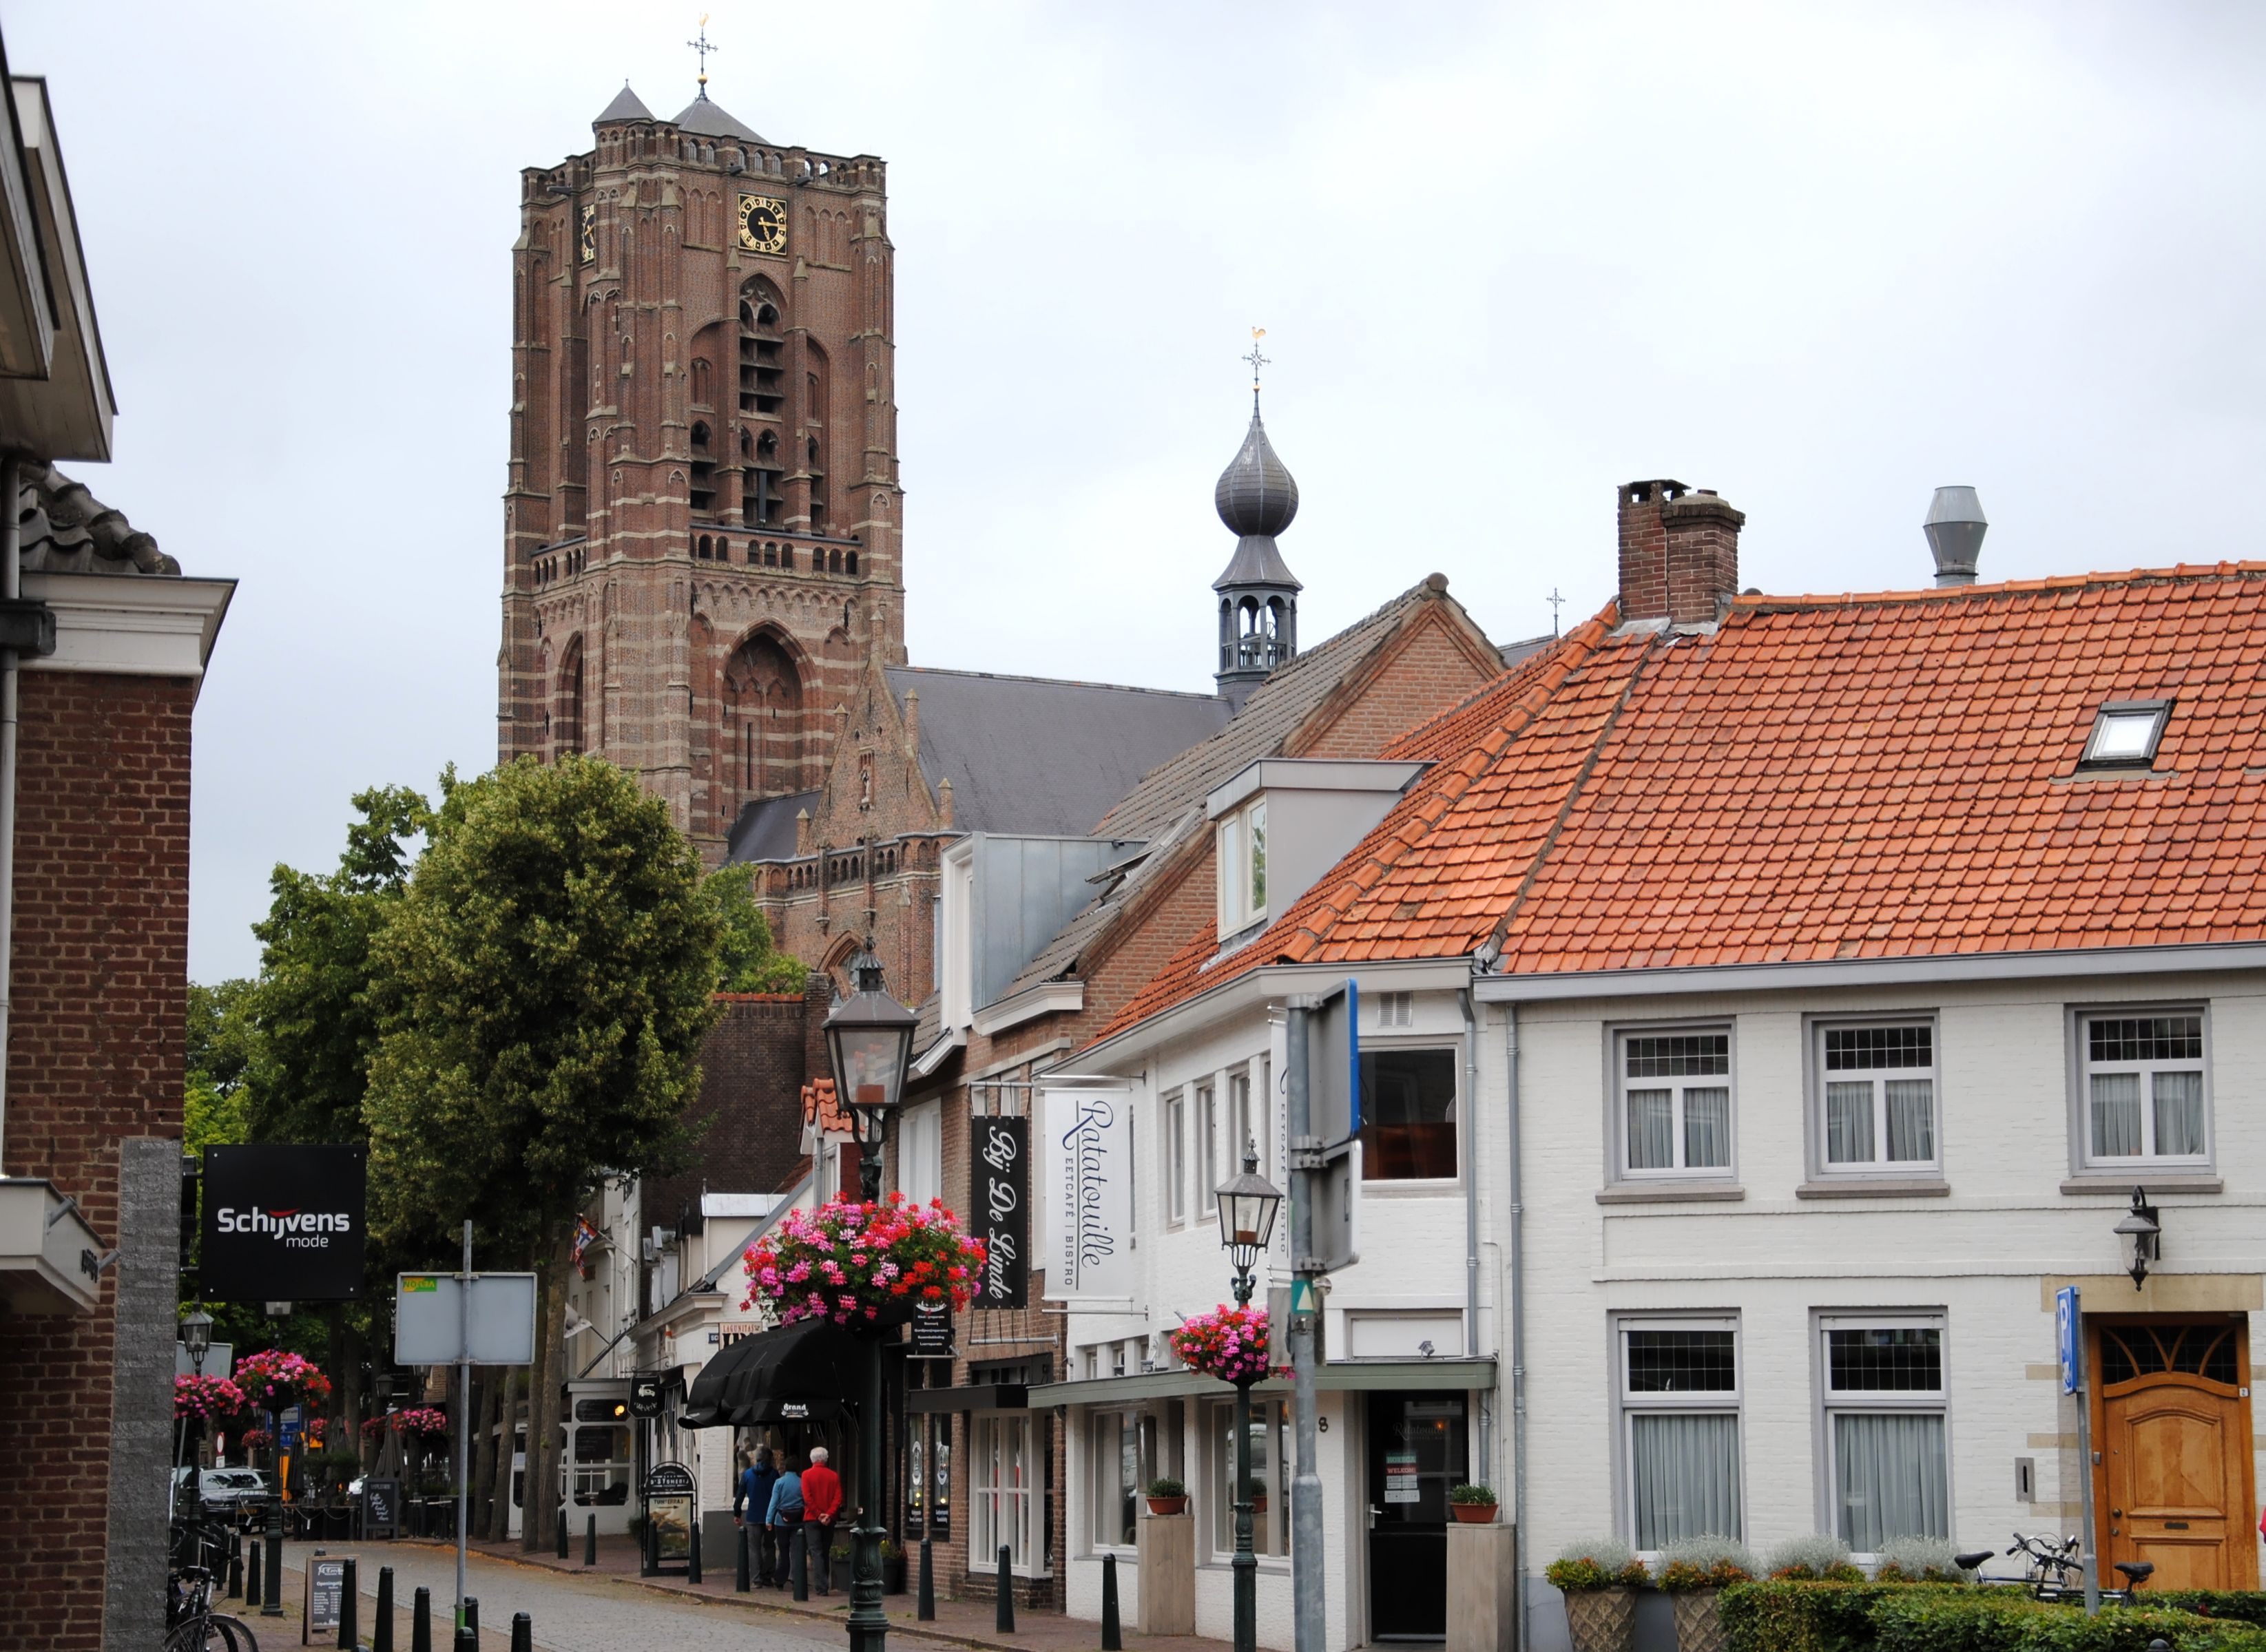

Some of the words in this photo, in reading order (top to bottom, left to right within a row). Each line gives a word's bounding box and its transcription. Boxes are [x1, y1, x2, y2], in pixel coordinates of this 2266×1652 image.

[989, 1177, 1017, 1222] De
[1062, 1100, 1114, 1268] Ratatouille
[1065, 1158, 1075, 1217] EETCAFÉ
[218, 1206, 350, 1240] Schijvens
[286, 1234, 329, 1248] mode
[989, 1227, 1017, 1299] Linde
[1064, 1235, 1074, 1286] BISTRO
[723, 1324, 754, 1332] LAGUNITAS
[783, 1403, 807, 1411] Brand
[1318, 1416, 1329, 1433] 8
